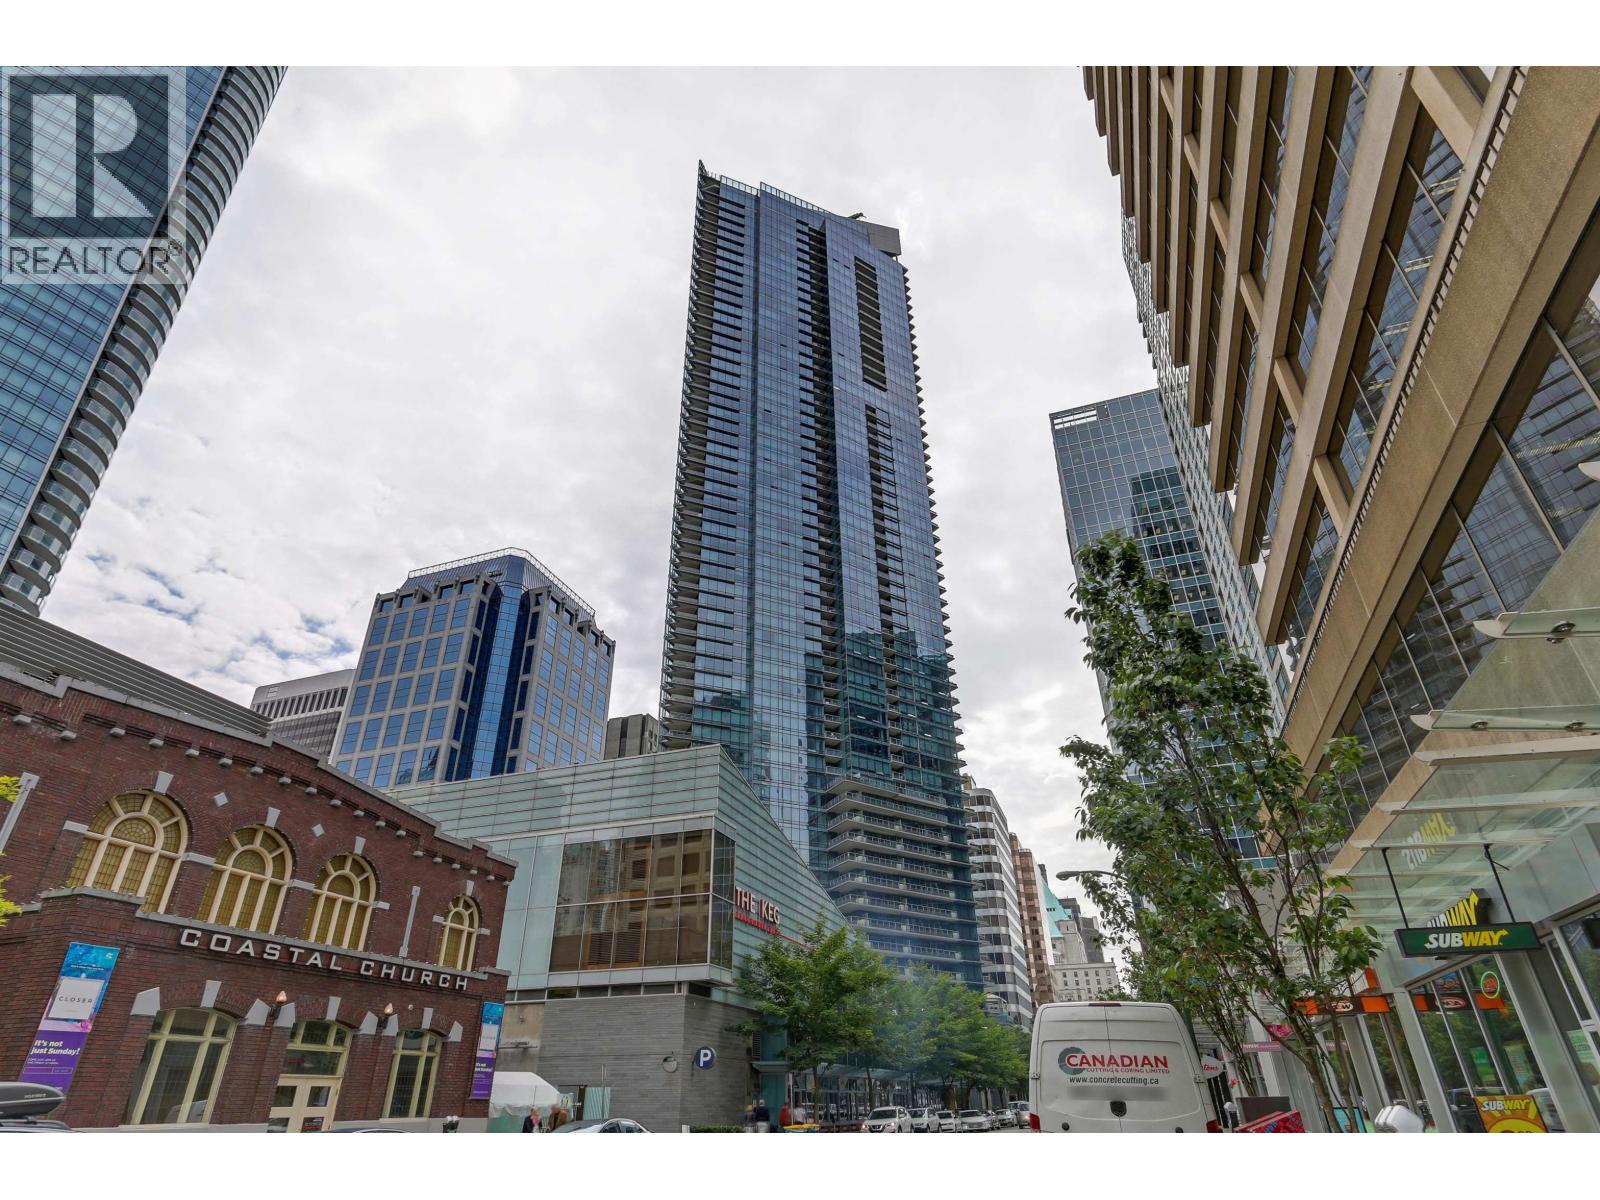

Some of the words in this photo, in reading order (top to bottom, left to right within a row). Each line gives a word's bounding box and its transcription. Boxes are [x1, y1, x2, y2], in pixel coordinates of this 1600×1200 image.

[735, 887, 756, 913] THE
[760, 899, 780, 924] KEG
[1425, 930, 1508, 948] SUBWAY
[180, 928, 342, 970] COASTAL
[360, 960, 468, 991] CHURCH
[58, 996, 93, 1004] CLOSER
[31, 1047, 47, 1055] just
[48, 1048, 80, 1056] Sunday!
[700, 1049, 712, 1067] P
[1066, 1055, 1168, 1068] CANADIAN
[1069, 1076, 1159, 1086] www.concretecutting.ca
[1481, 1099, 1529, 1111] SUBWAY
